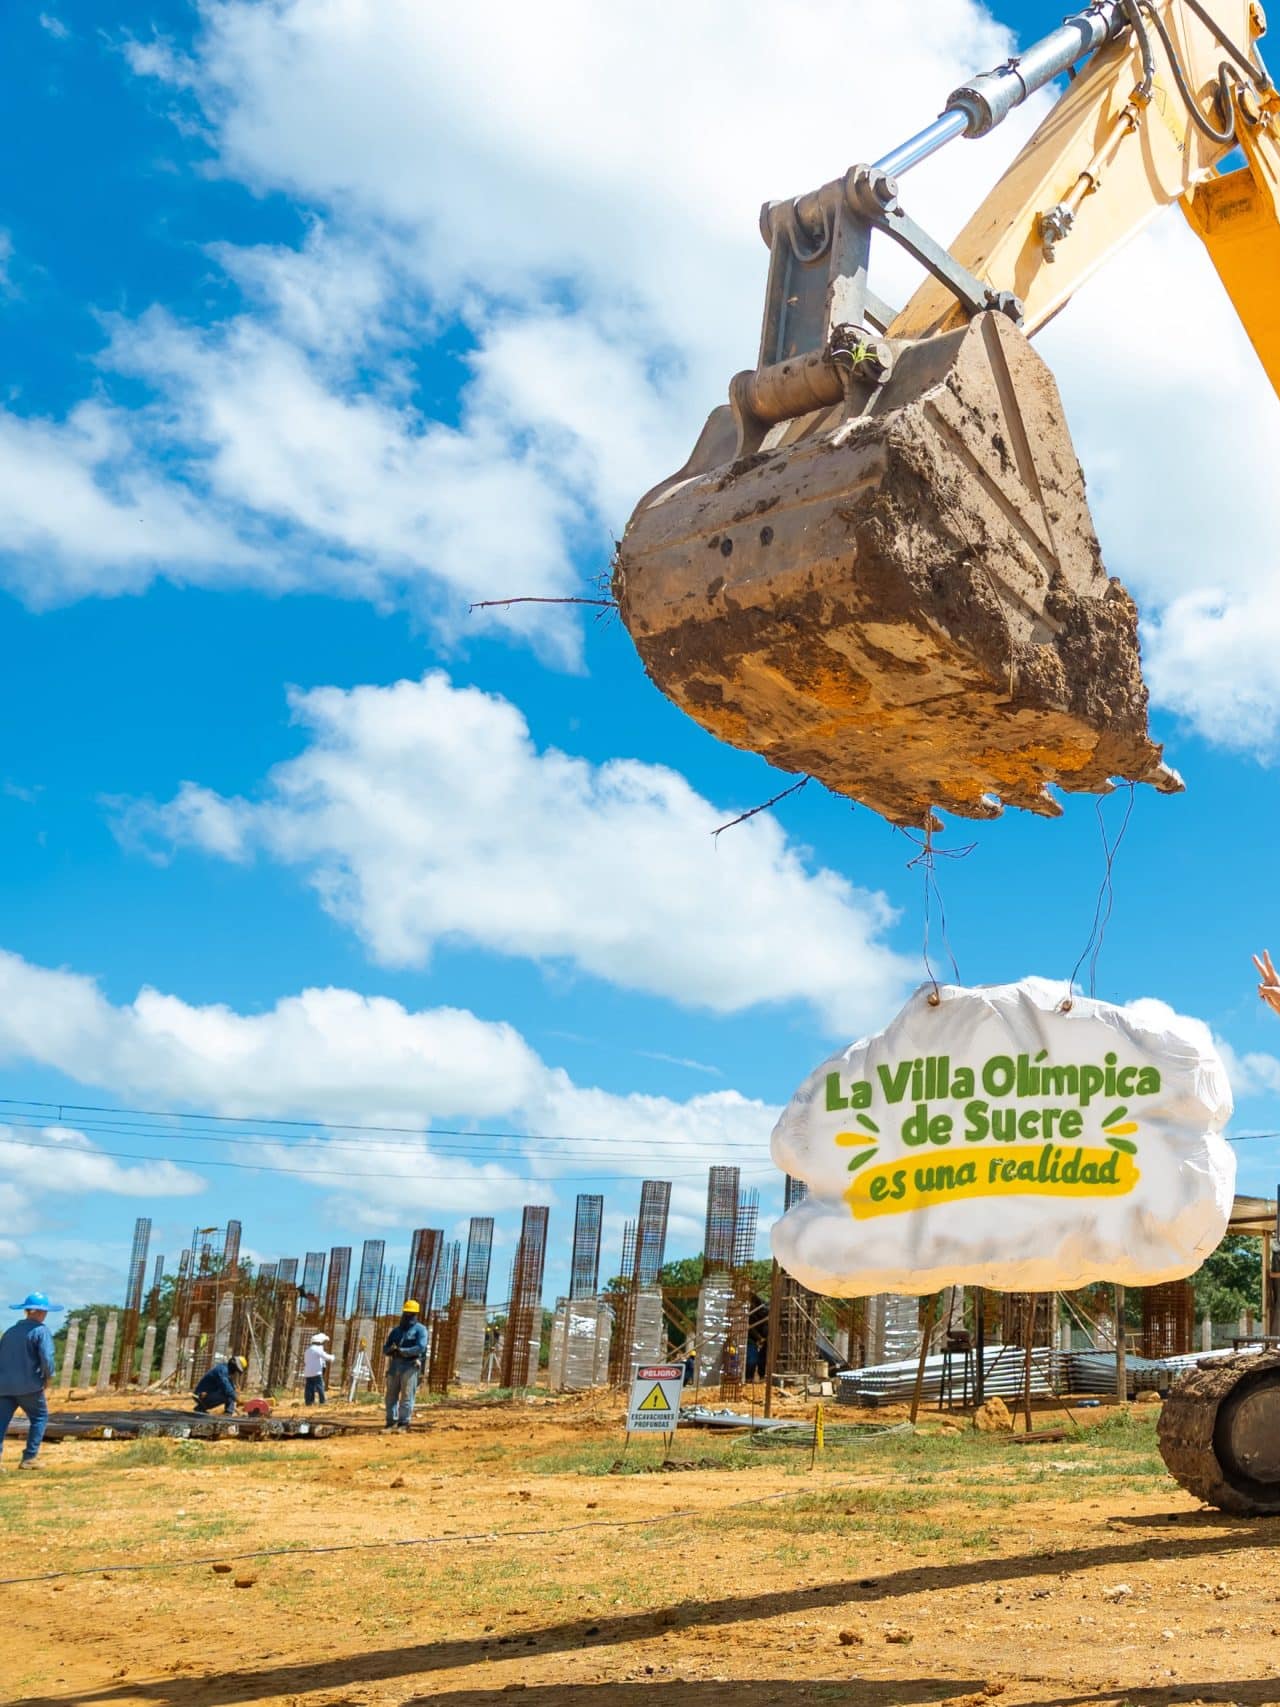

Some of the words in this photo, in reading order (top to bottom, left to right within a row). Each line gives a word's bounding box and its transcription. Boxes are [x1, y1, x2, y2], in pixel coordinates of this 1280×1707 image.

[825, 1072, 872, 1112] La
[877, 1055, 975, 1104] Villa
[982, 1049, 1161, 1106] Olímpica
[901, 1103, 953, 1147] de
[964, 1099, 1084, 1143] Sucre
[870, 1168, 907, 1202] es
[915, 1160, 976, 1192] una
[988, 1144, 1121, 1185] realidad
[643, 1369, 677, 1377] PELIGRO
[631, 1413, 675, 1421] EXCAVACIONES
